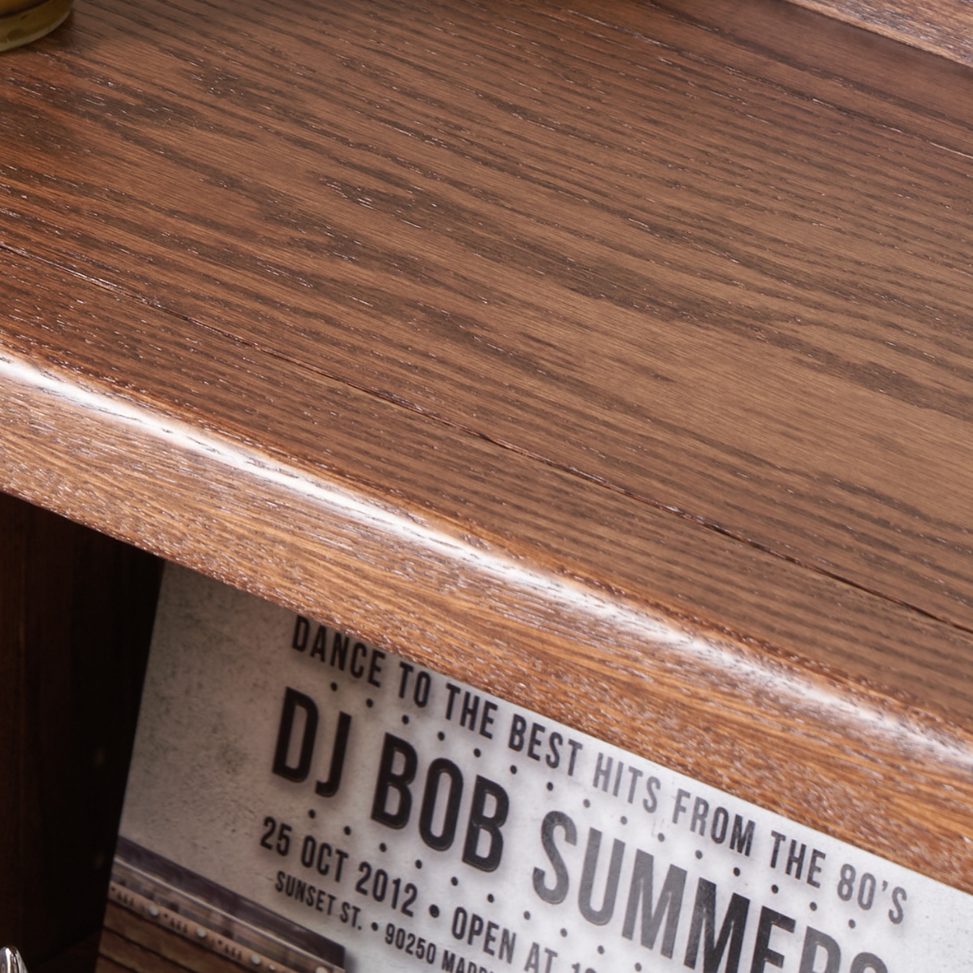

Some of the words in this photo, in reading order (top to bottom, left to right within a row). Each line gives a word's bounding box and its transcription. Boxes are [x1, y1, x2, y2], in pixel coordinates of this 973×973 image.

[272, 686, 352, 798] DJ
[370, 732, 509, 872] BOB
[532, 810, 888, 973] SUMME
[291, 615, 386, 689] DANCE
[398, 660, 432, 709] TO
[445, 682, 499, 739] THE
[508, 713, 583, 777] BEST
[592, 752, 661, 813] HITS
[672, 788, 756, 857] FROM
[770, 830, 826, 889] THE
[260, 816, 292, 857] 25
[300, 835, 349, 883] OCT
[355, 861, 418, 917] 2012
[452, 906, 516, 964] OPEN
[524, 942, 558, 973] AT
[275, 871, 337, 916] SUNSET
[340, 902, 362, 931] ST.
[384, 923, 437, 964] 90250
